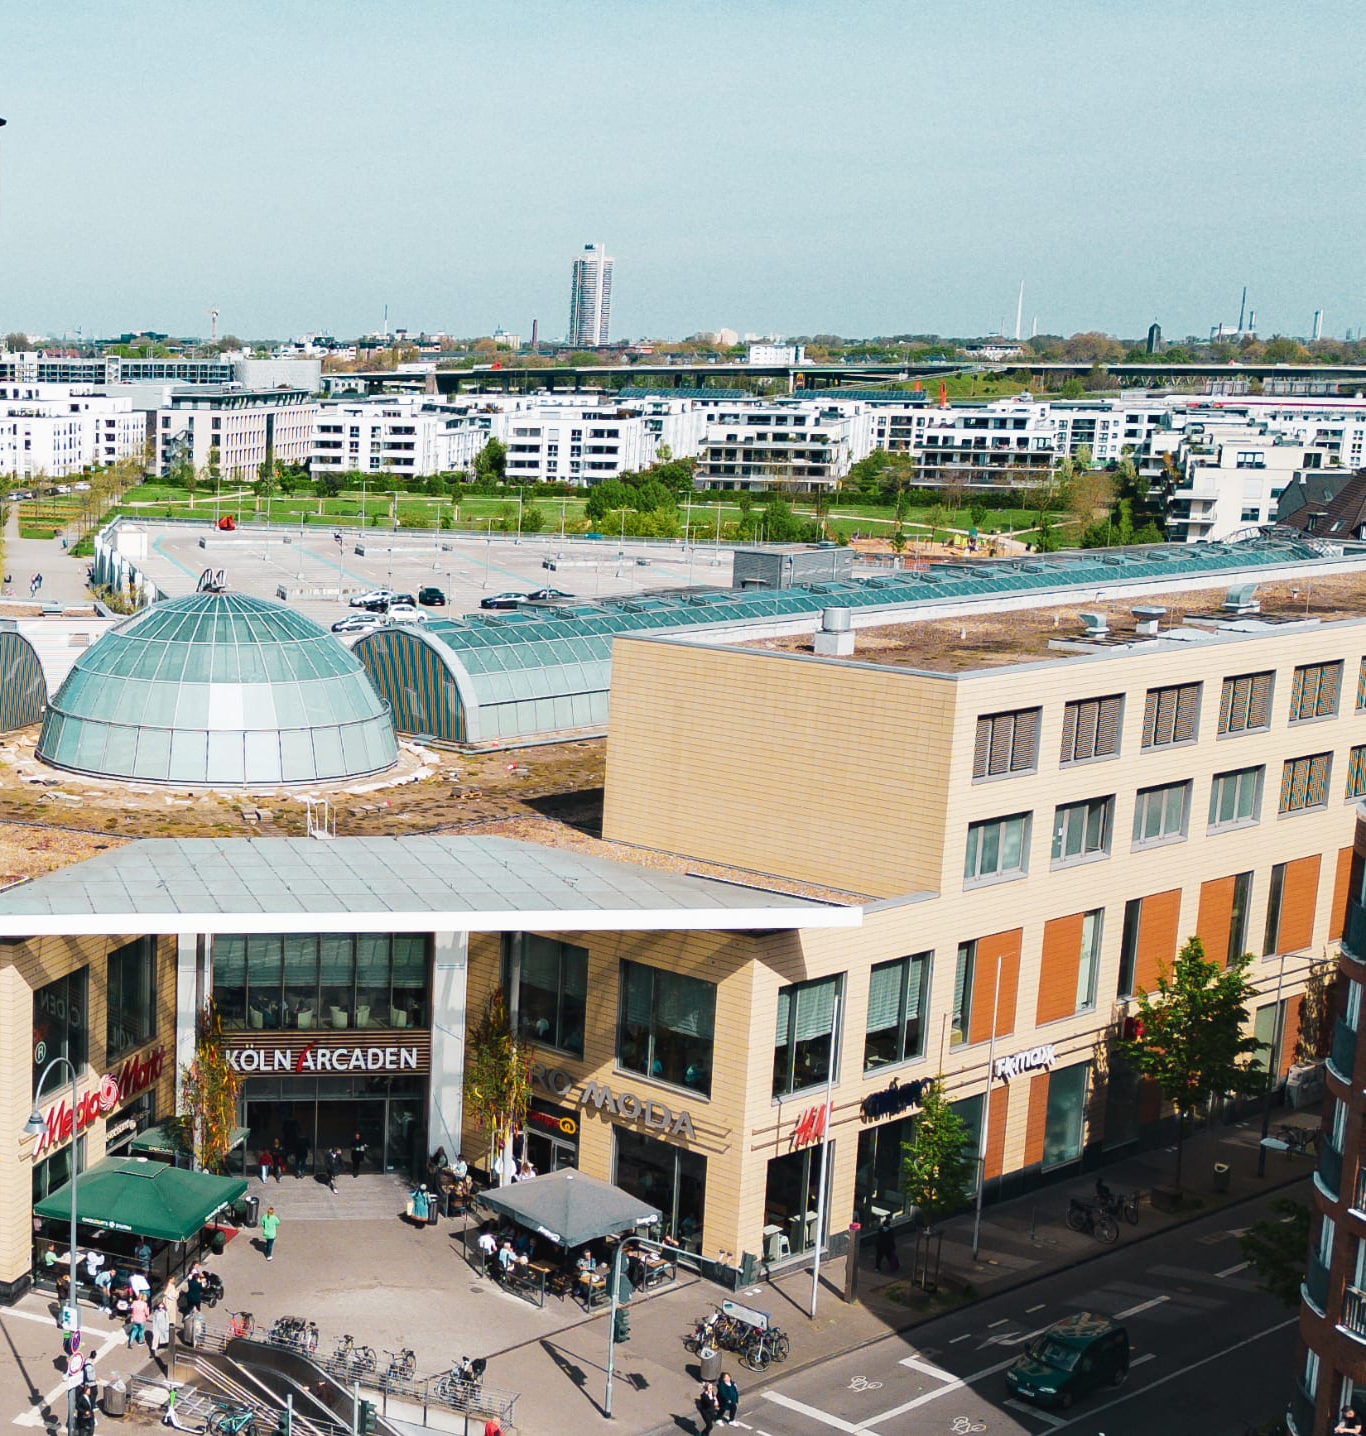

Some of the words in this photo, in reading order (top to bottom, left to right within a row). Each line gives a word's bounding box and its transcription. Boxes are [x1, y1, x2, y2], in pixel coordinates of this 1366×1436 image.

[225, 1043, 291, 1072] KÖLN
[295, 1040, 418, 1073] ARCADEN
[33, 1090, 101, 1156] Media
[118, 1043, 166, 1100] Markt
[580, 1081, 697, 1140] MODA
